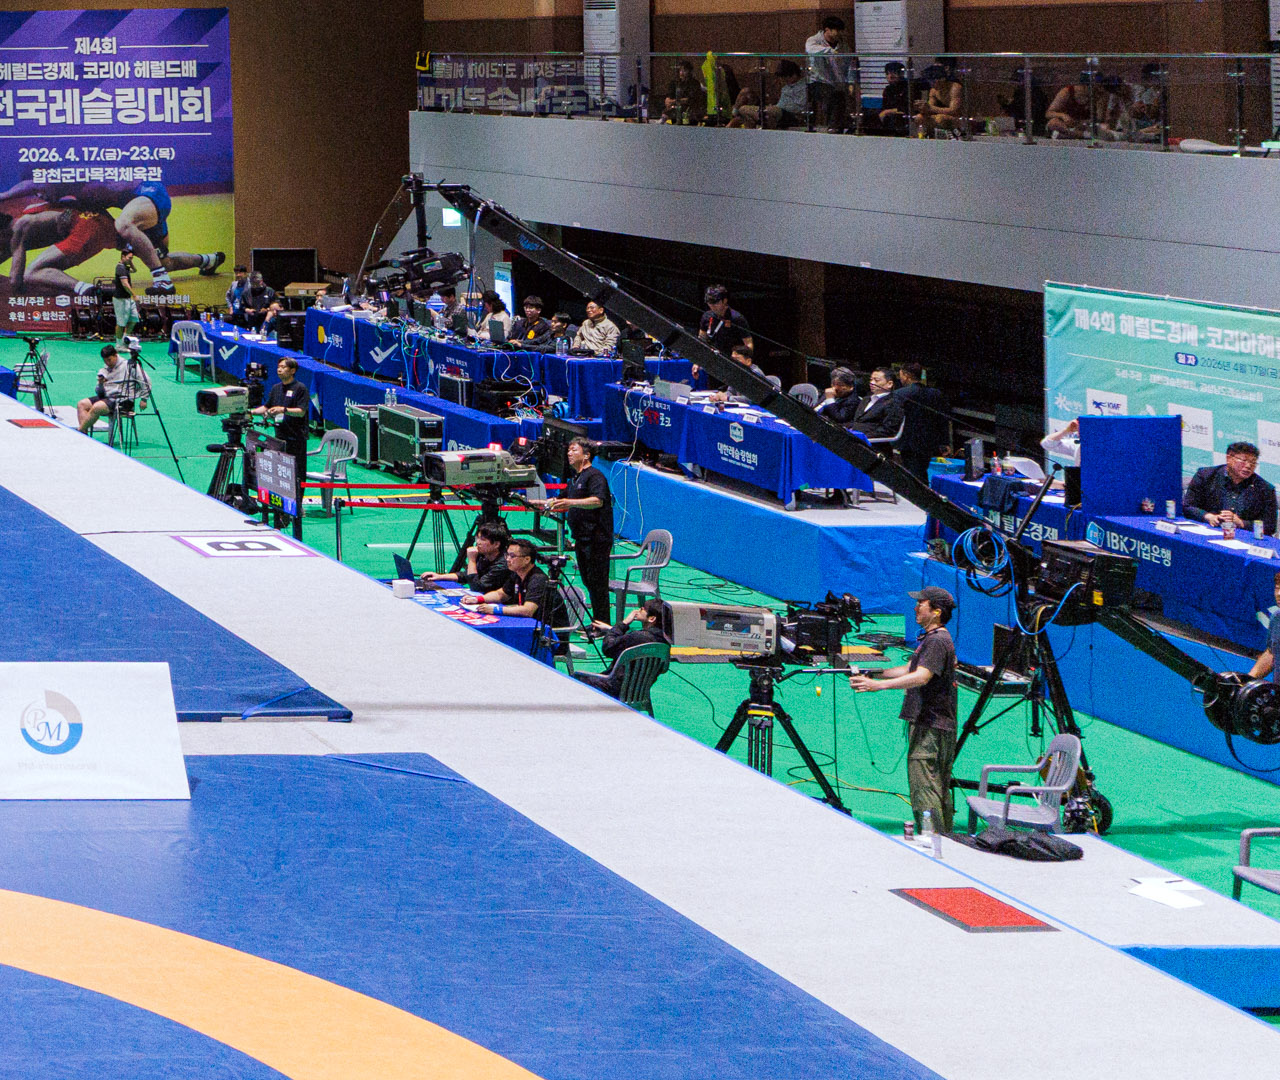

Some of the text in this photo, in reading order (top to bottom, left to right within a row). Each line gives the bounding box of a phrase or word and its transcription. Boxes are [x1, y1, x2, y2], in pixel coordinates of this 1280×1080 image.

[75, 36, 117, 55] 제4회
[83, 61, 131, 80] 코리아
[134, 60, 197, 78] 헤럴드배
[18, 148, 62, 163] 2026.
[65, 147, 80, 162] 4.
[32, 166, 162, 183] 합천군다목적체육관
[8, 311, 25, 321] 후원
[1074, 308, 1116, 334] 제4회
